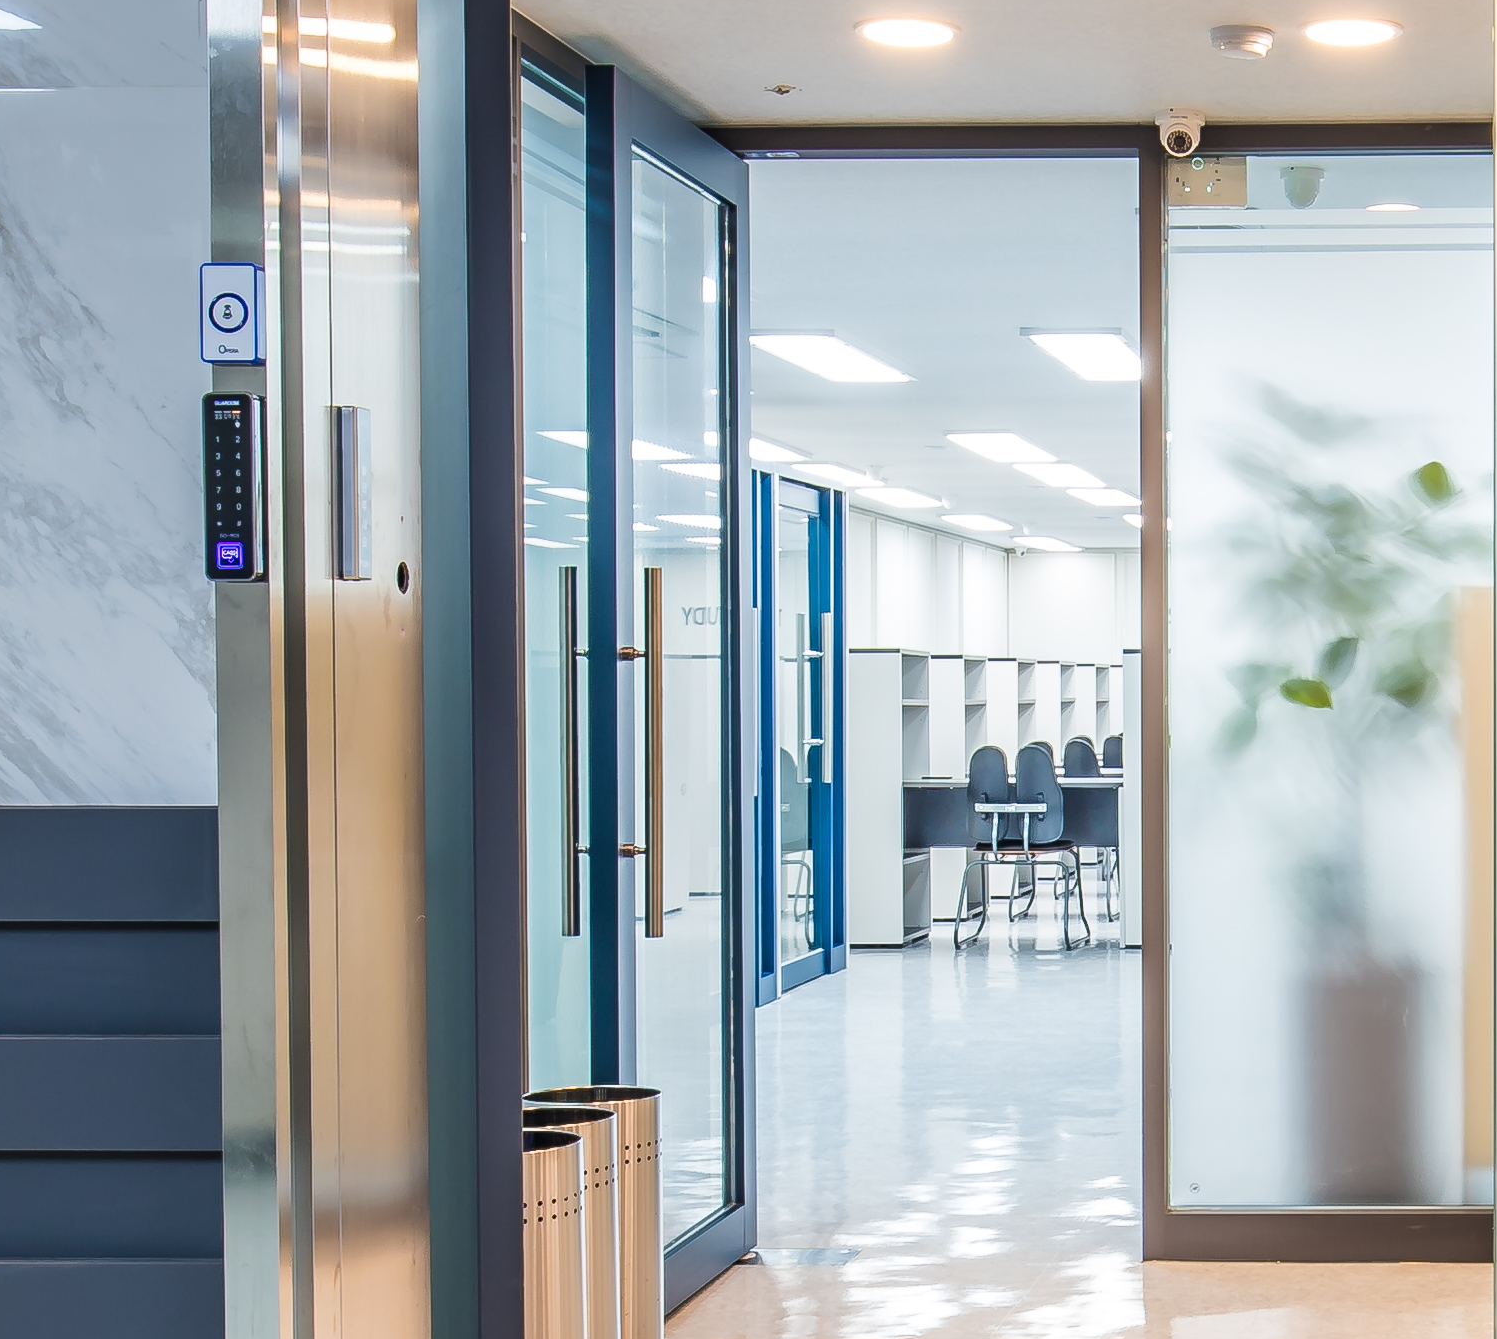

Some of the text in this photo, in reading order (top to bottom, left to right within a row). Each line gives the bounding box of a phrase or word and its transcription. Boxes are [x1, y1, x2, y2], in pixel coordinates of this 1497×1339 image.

[215, 435, 241, 443] 1 2
[215, 452, 241, 460] 3 4
[215, 469, 241, 477] 5 6
[215, 486, 222, 494] 7
[216, 503, 242, 511] 9 0
